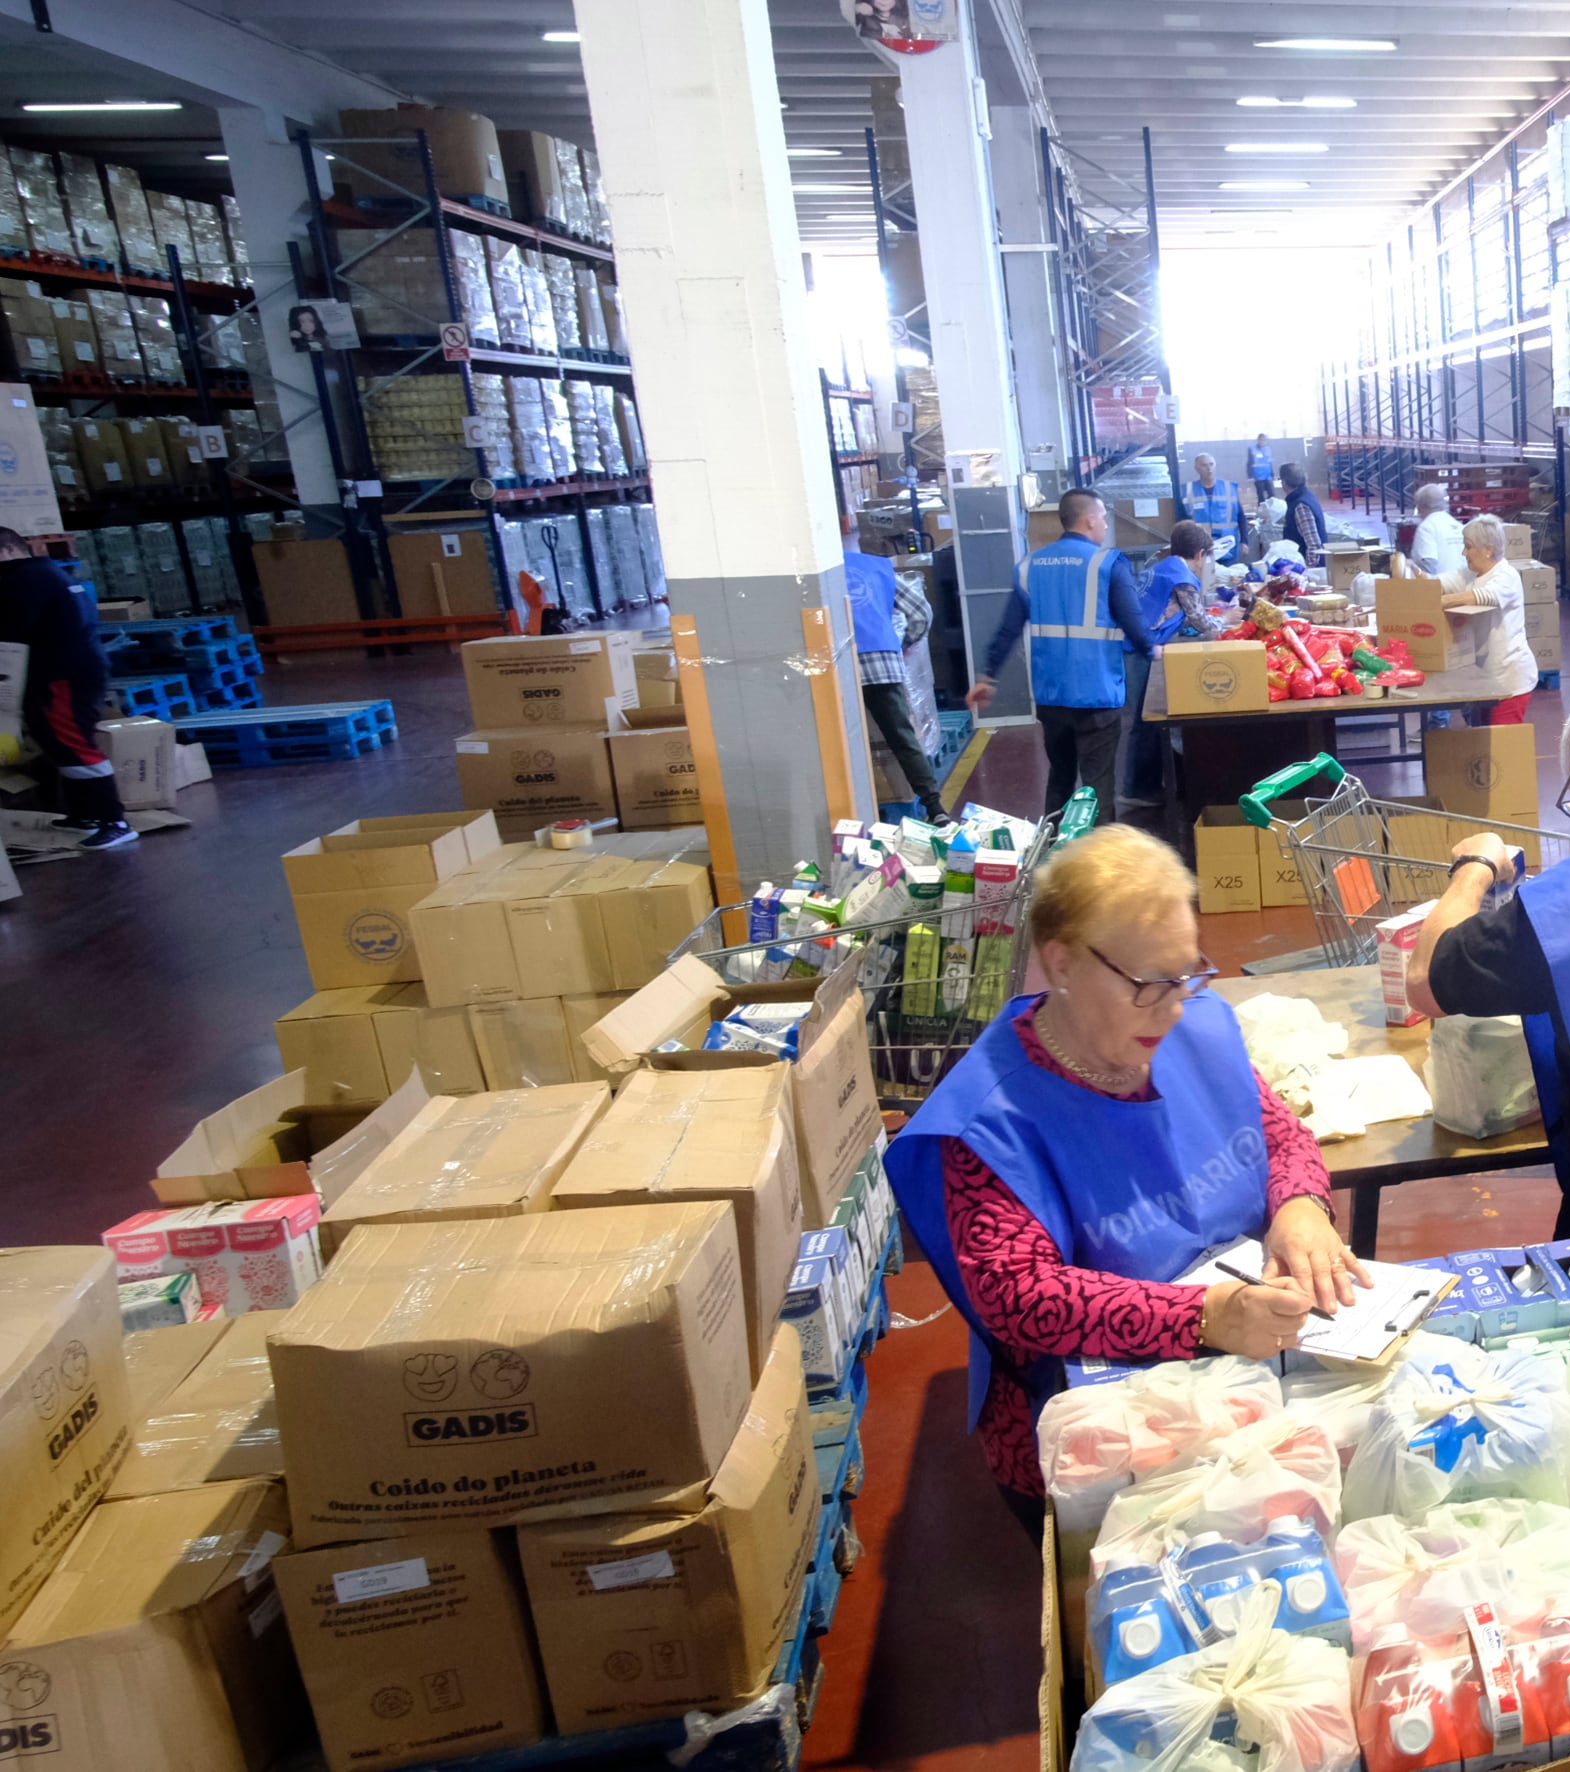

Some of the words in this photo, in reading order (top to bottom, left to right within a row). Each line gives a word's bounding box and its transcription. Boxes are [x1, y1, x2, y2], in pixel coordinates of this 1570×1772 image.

[1167, 404, 1177, 420] E
[894, 408, 909, 430] D
[469, 425, 481, 442] C
[207, 435, 221, 452] B
[1508, 538, 1524, 546] X25
[523, 689, 561, 698] GADIS
[669, 765, 696, 774] GAD
[515, 773, 555, 784] GADIS
[1276, 870, 1303, 882] X25
[1213, 876, 1243, 889] X25
[356, 924, 394, 934] FESBAL
[946, 952, 966, 962] RAM
[1083, 1126, 1263, 1250] VOLUNARI@
[236, 1224, 274, 1235] Campo
[118, 1237, 156, 1246] Campo
[178, 1231, 215, 1241] Campo
[235, 1232, 278, 1243] Nuestro
[177, 1238, 219, 1249] Nuestro
[48, 1392, 99, 1461] GADIS
[412, 1411, 530, 1441] GADIS
[370, 1479, 445, 1499] Coido
[453, 1476, 485, 1494] do
[495, 1459, 597, 1490] planeta
[328, 1499, 381, 1512] Outras
[0, 1722, 51, 1750] DIS
